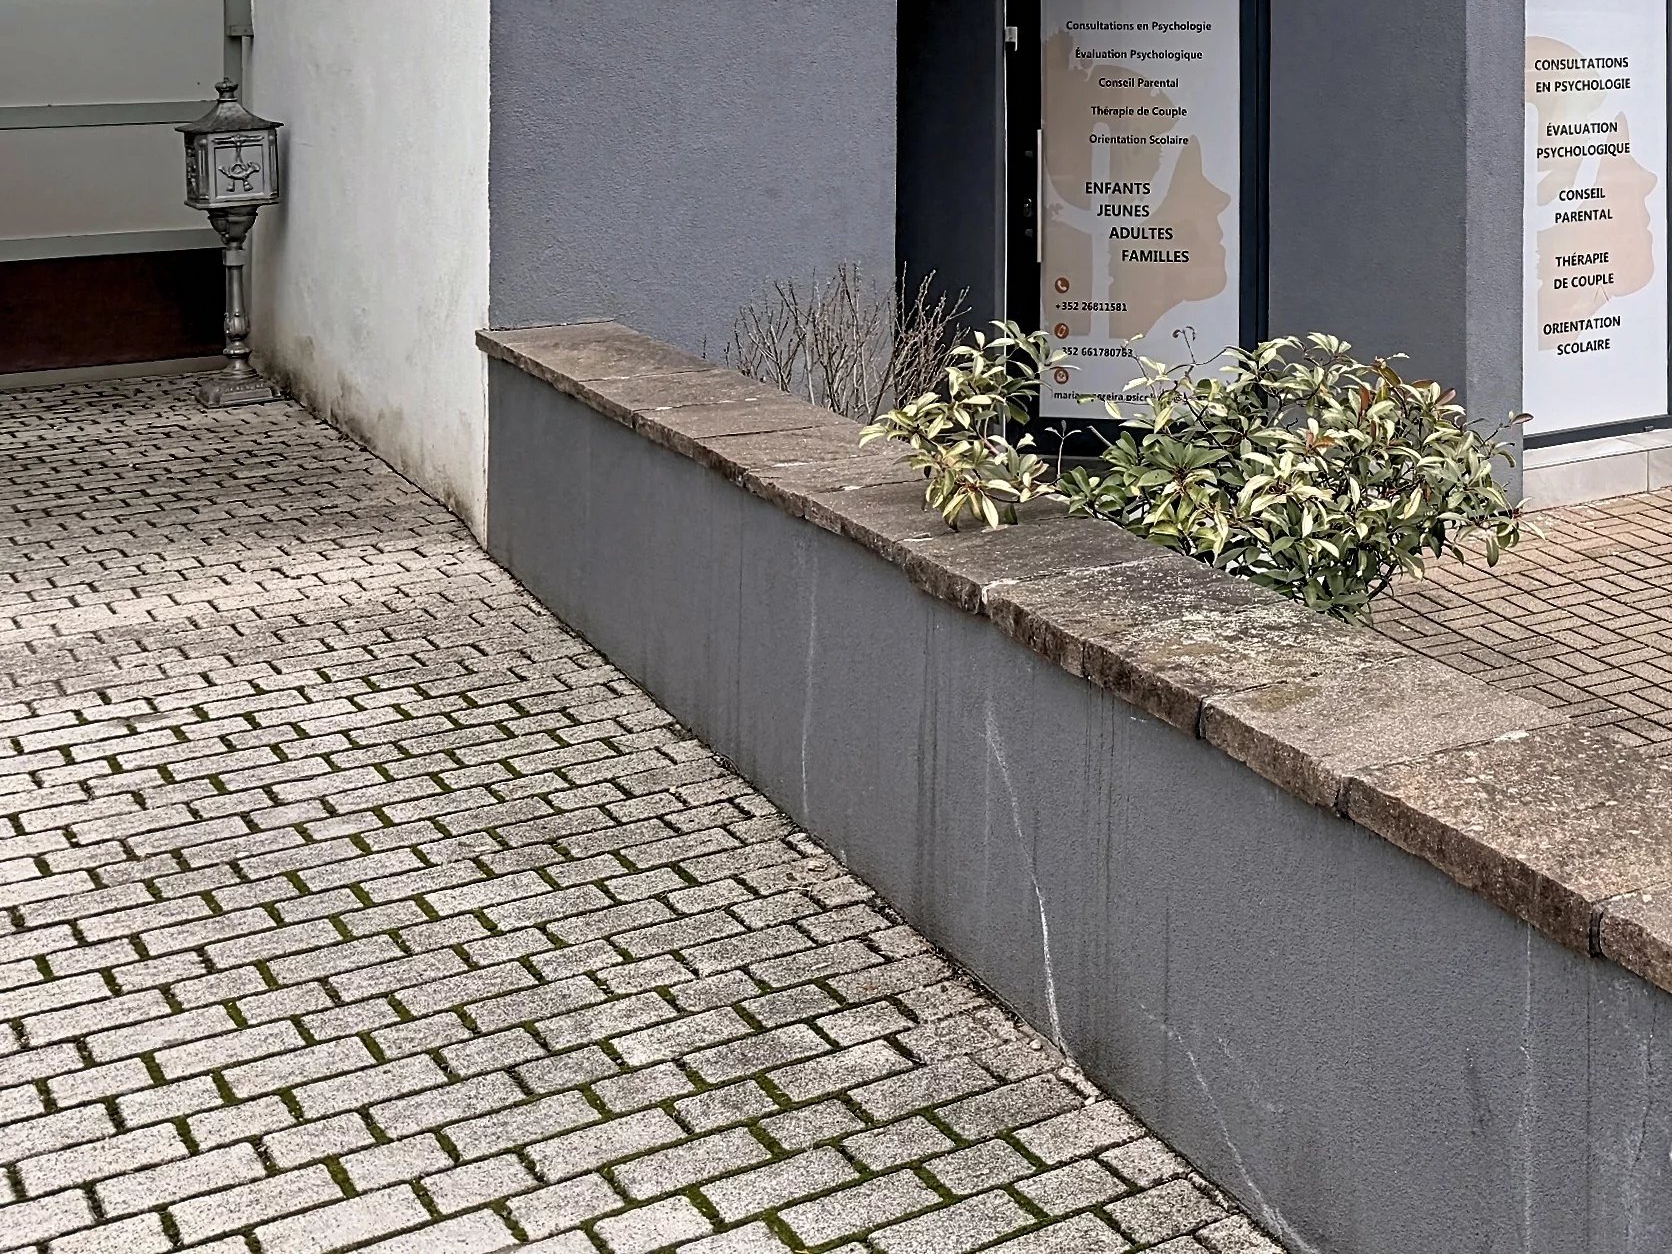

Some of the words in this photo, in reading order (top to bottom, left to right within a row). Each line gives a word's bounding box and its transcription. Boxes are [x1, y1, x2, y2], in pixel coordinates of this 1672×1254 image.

[1065, 21, 1134, 31] Consultations
[1136, 23, 1149, 31] en
[1152, 21, 1212, 33] Psychologie
[1075, 47, 1127, 59] Évaluation
[1130, 49, 1203, 61] Psychologique
[1534, 57, 1629, 71] CONSULTATIONS
[1098, 77, 1135, 88] Conseil
[1137, 78, 1179, 88] Parental
[1536, 81, 1550, 93] EN
[1555, 78, 1631, 92] PSYCHOLOGIE
[1091, 106, 1134, 118] Thérapie
[1137, 106, 1149, 117] de
[1152, 107, 1187, 119] Couple
[1546, 122, 1618, 136] ÉVALUATION
[1089, 134, 1146, 145] Orientation
[1149, 134, 1189, 145] Scolaire
[1536, 143, 1630, 159] PSYCHOLOGIQUE
[1085, 182, 1151, 195] ENFANTS
[1559, 187, 1606, 201] CONSEIL
[1097, 204, 1150, 218] JEUNES
[1555, 209, 1613, 223] PARENTAL
[1109, 227, 1174, 240] ADULTES
[1121, 250, 1190, 263] FAMILLES
[1555, 252, 1609, 267] THÉRAPIE
[1554, 277, 1568, 289] DE
[1571, 273, 1614, 288] COUPLE
[1543, 316, 1621, 335] ORIENTATION
[1557, 338, 1610, 355] SCOLAIRE
